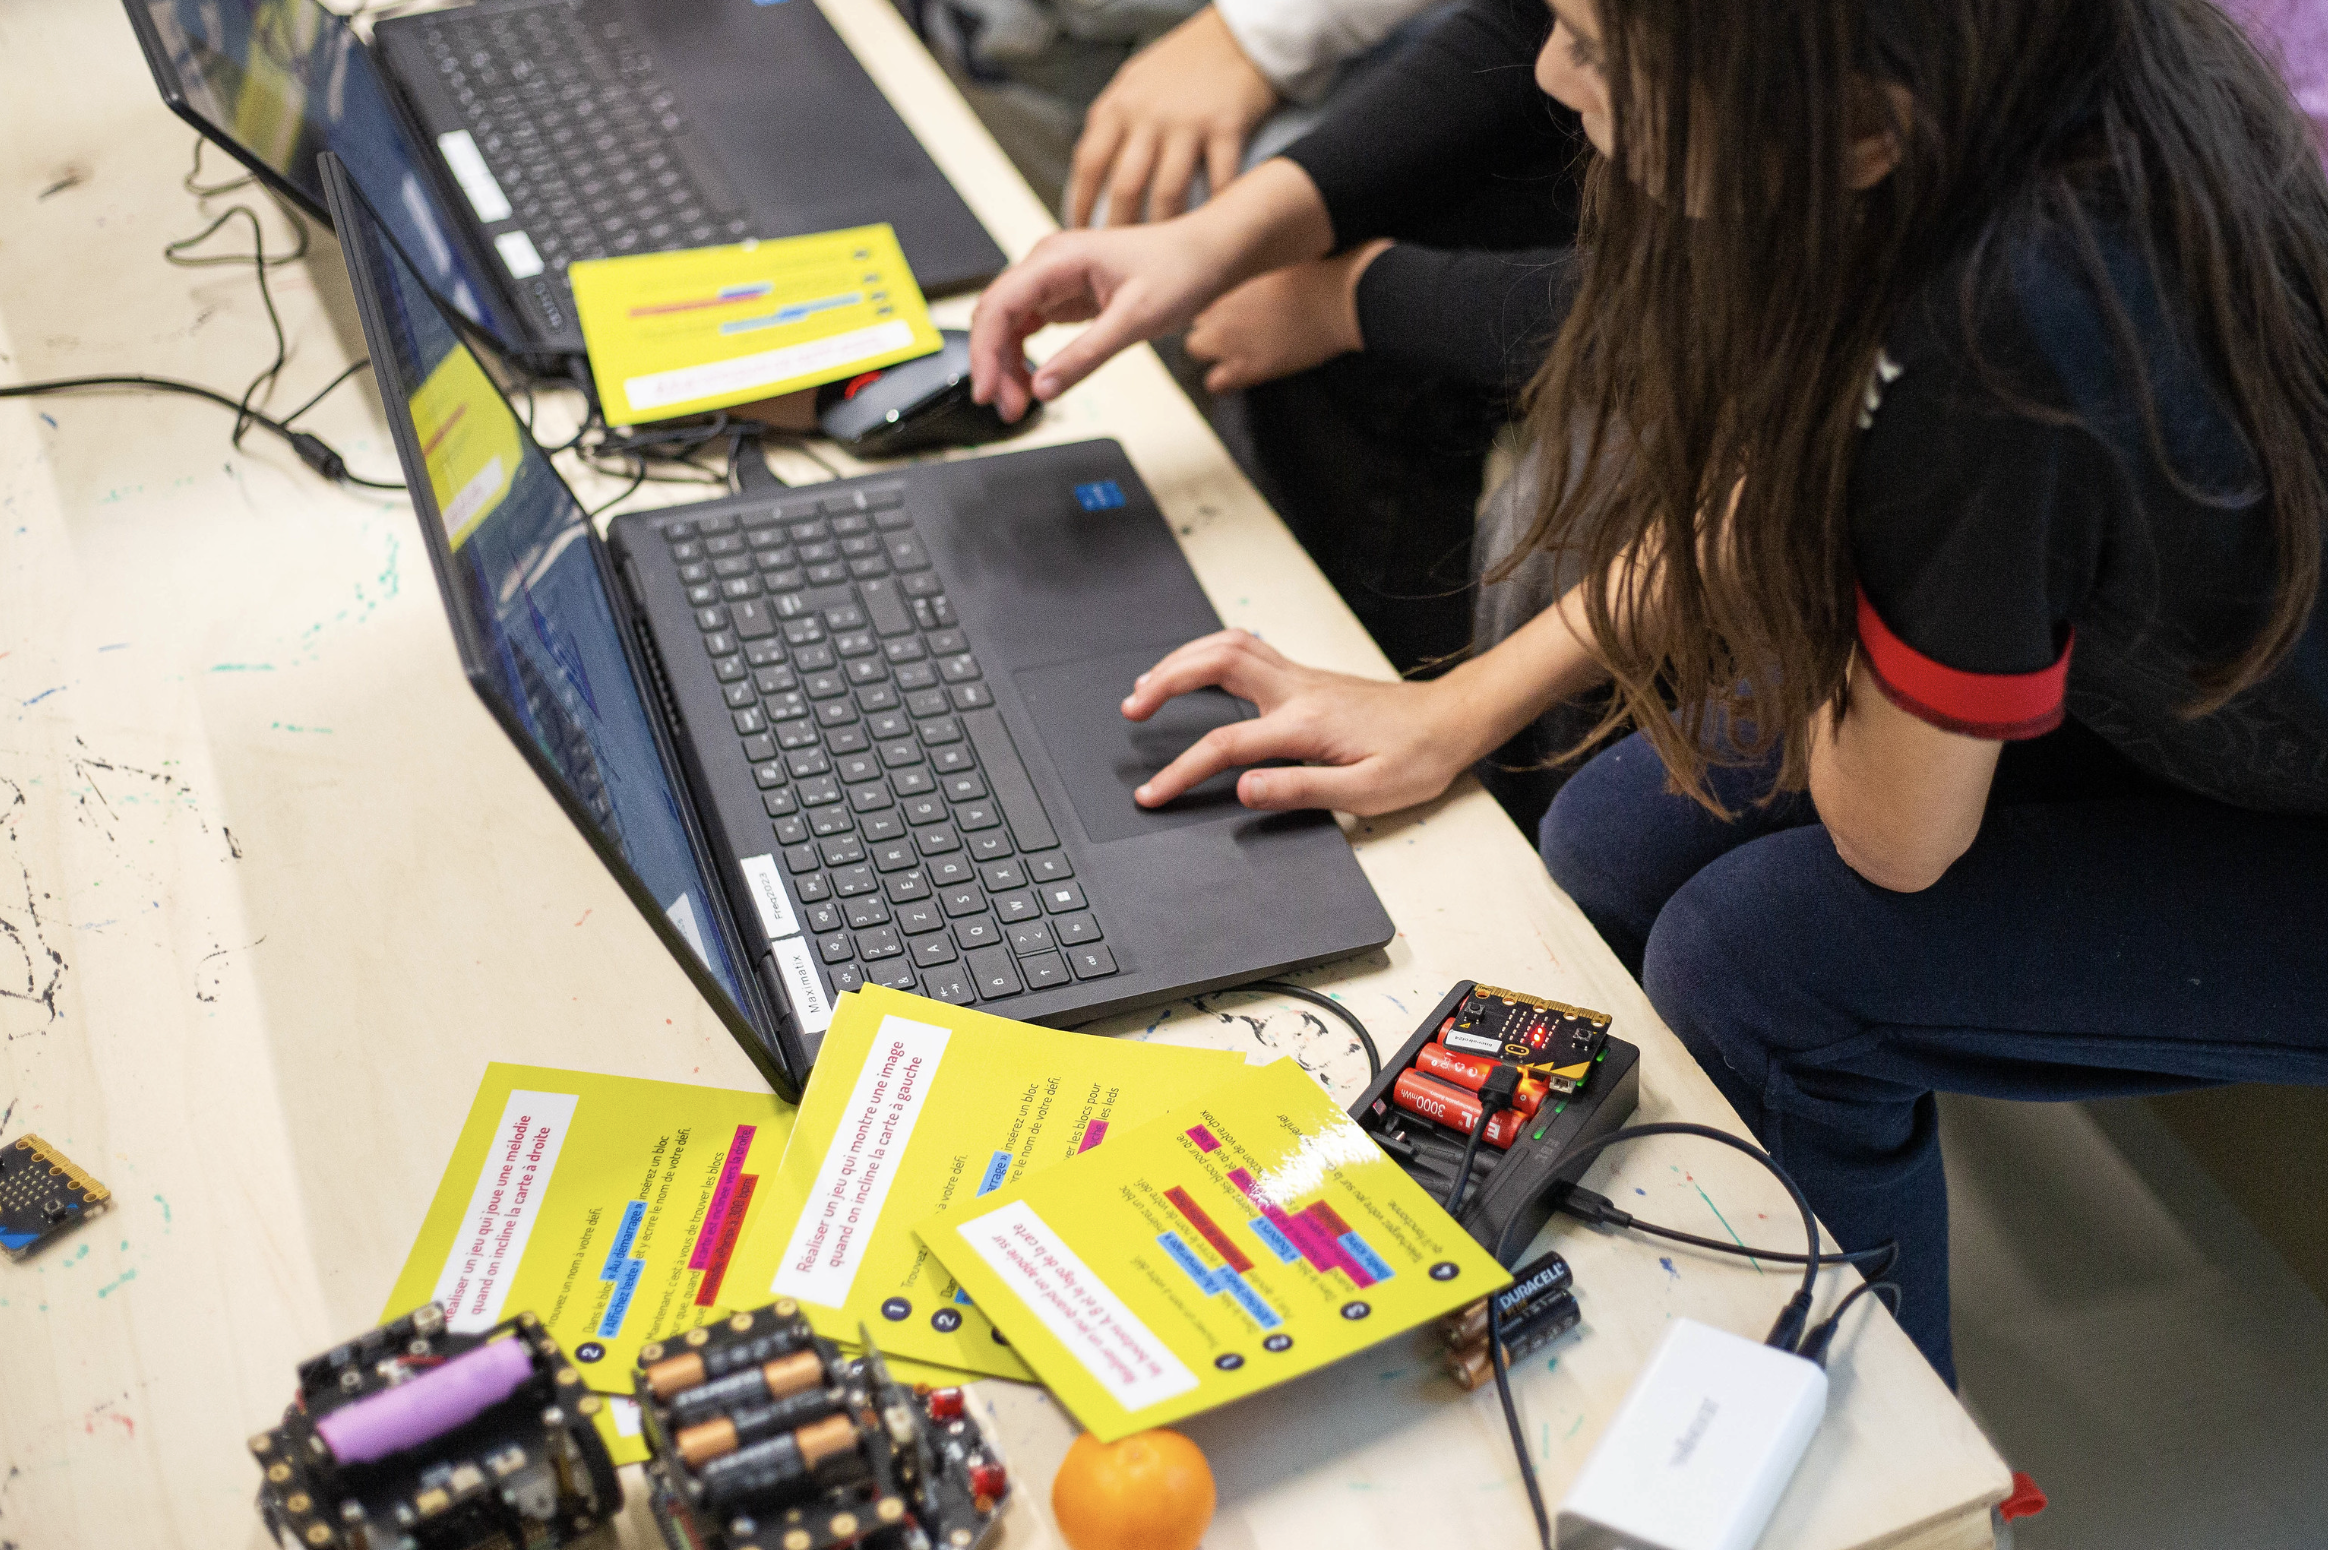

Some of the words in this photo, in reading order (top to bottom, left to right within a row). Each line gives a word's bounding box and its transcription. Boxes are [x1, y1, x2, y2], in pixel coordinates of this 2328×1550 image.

[759, 872, 783, 920] Freq2023
[793, 955, 820, 1013] Maximatix
[896, 1056, 923, 1102] gauche
[1044, 1077, 1061, 1097] défi.
[1020, 1083, 1040, 1103] bloc
[1086, 1082, 1102, 1105] pour
[1101, 1087, 1120, 1107] leds
[1018, 1104, 1030, 1117] un
[1036, 1096, 1053, 1121] votre
[1072, 1105, 1094, 1130] blocs
[1095, 1107, 1112, 1121] les
[1200, 1109, 1221, 1129] choix
[878, 1112, 900, 1146] carte
[1004, 1117, 1026, 1152] insérez
[1028, 1122, 1043, 1135] de
[1216, 1127, 1237, 1146] votre
[1276, 1114, 1304, 1138] vérifier
[505, 1114, 532, 1163] mélodie
[525, 1126, 551, 1163] droite
[651, 1135, 670, 1154] bloc
[675, 1128, 691, 1146] défi.
[1020, 1136, 1036, 1158] nom
[1066, 1130, 1084, 1145] les
[1175, 1131, 1197, 1149] que,
[669, 1146, 685, 1170] votre
[795, 1219, 830, 1273] Réaliser
[823, 1200, 838, 1218] un
[831, 1177, 848, 1201] jeu
[840, 1155, 858, 1177] qui
[849, 1106, 878, 1153] montre
[870, 1080, 888, 1105] une
[880, 1040, 906, 1079] image
[867, 1147, 886, 1160] la
[1188, 1146, 1210, 1165] pour
[1211, 1147, 1230, 1163] que
[1232, 1144, 1246, 1155] de
[651, 1155, 662, 1167] un
[706, 1151, 725, 1175] blocs
[1013, 1158, 1028, 1169] le
[497, 1164, 514, 1187] une
[638, 1168, 658, 1200] insérez
[661, 1170, 676, 1182] de
[700, 1175, 717, 1189] les
[854, 1161, 881, 1205] incline
[941, 1175, 959, 1202] votre
[950, 1155, 967, 1176] défi.
[1203, 1163, 1225, 1184] blocs
[514, 1173, 534, 1205] carte
[655, 1183, 670, 1204] nom
[1118, 1185, 1137, 1202] bloc
[1219, 1180, 1236, 1195] des
[485, 1188, 505, 1216] joue
[503, 1206, 522, 1218] la
[689, 1189, 710, 1223] trouver
[1148, 1192, 1169, 1212] votre
[586, 1208, 602, 1226] défi.
[847, 1206, 861, 1224] on
[477, 1216, 494, 1237] qui
[612, 1209, 646, 1259] démarrage
[641, 1215, 659, 1242] écrire
[685, 1224, 699, 1236] de
[1012, 1223, 1039, 1247] carte
[469, 1237, 486, 1257] jeu
[493, 1219, 517, 1259] incline
[578, 1226, 596, 1251] votre
[679, 1237, 694, 1258] vous
[828, 1224, 854, 1269] quand
[992, 1232, 1010, 1250] sur
[464, 1258, 477, 1274] un
[487, 1260, 500, 1276] on
[567, 1259, 580, 1280] nom
[901, 1248, 929, 1287] Trouvez
[1006, 1248, 1039, 1279] appuie
[1041, 1255, 1059, 1268] de
[562, 1281, 572, 1293] un
[620, 1266, 639, 1291] texte
[1034, 1279, 1049, 1291] on
[1054, 1267, 1077, 1289] logo
[1500, 1262, 1565, 1309] DURACELL
[470, 1277, 495, 1316] quand
[596, 1280, 614, 1300] bloc
